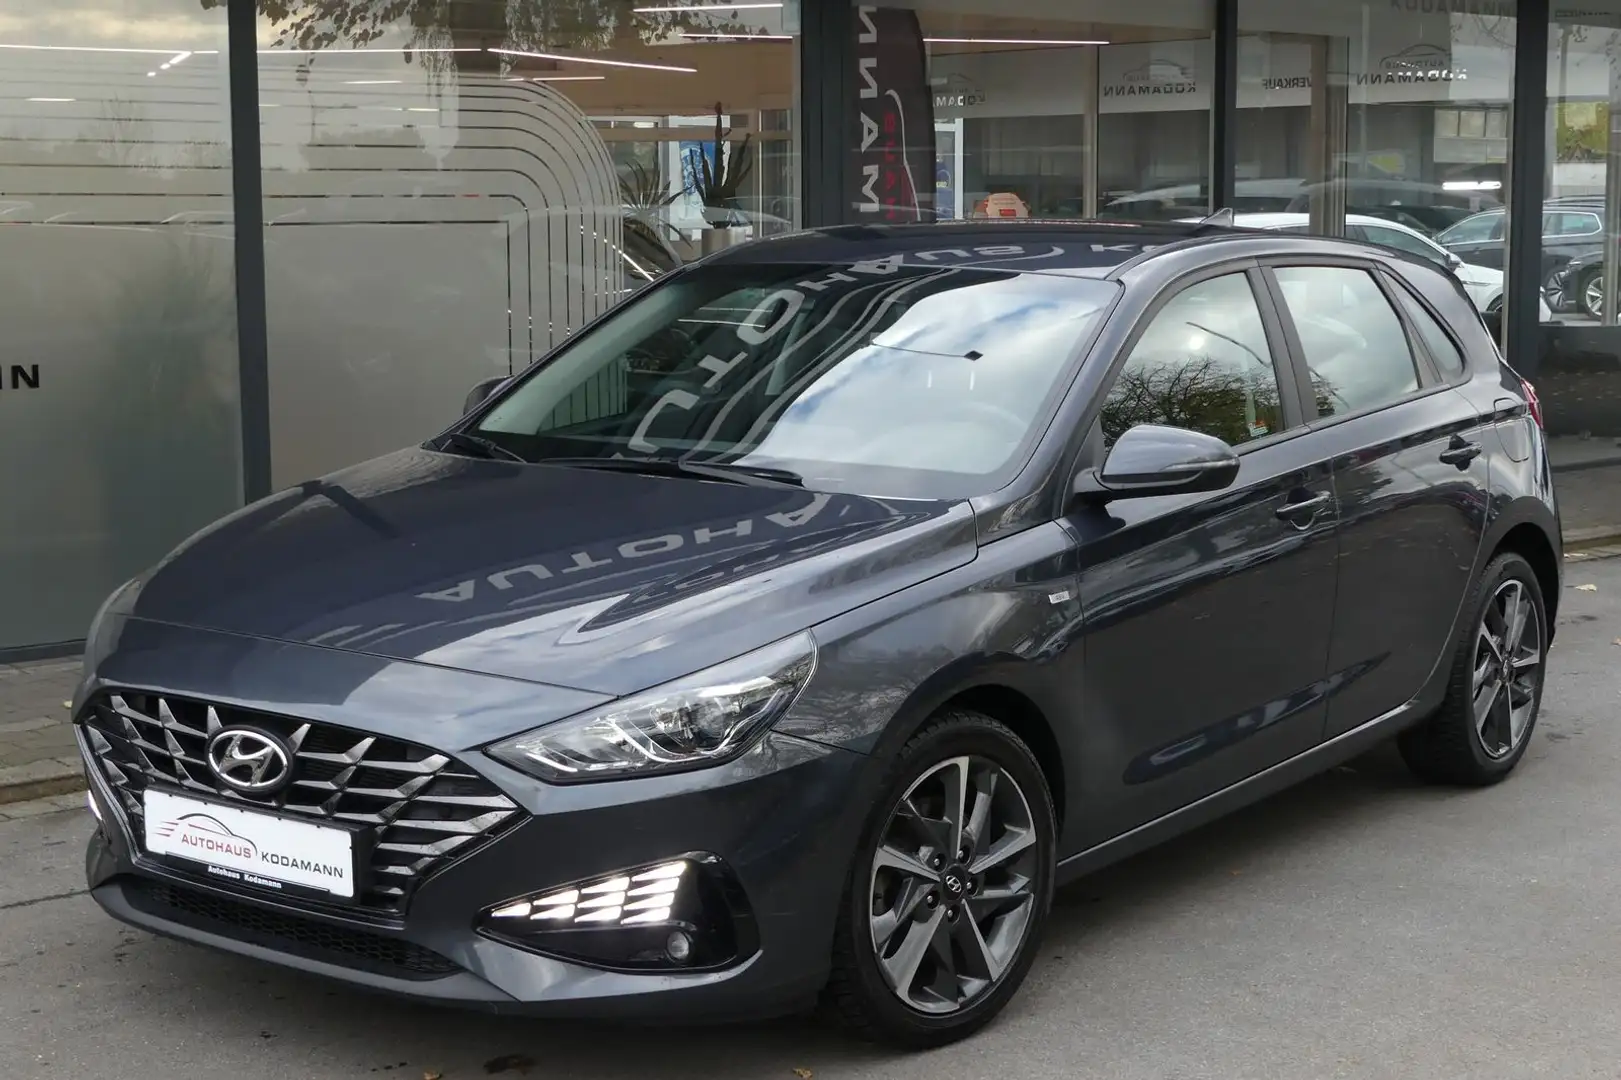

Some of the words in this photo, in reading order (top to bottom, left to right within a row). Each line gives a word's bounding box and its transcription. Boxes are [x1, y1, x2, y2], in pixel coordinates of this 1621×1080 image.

[0, 364, 40, 390] N
[181, 833, 252, 859] AUTOHAUS
[261, 851, 344, 879] KODAMANN
[207, 865, 240, 880] Autohaus
[243, 872, 282, 889] Kodamann
